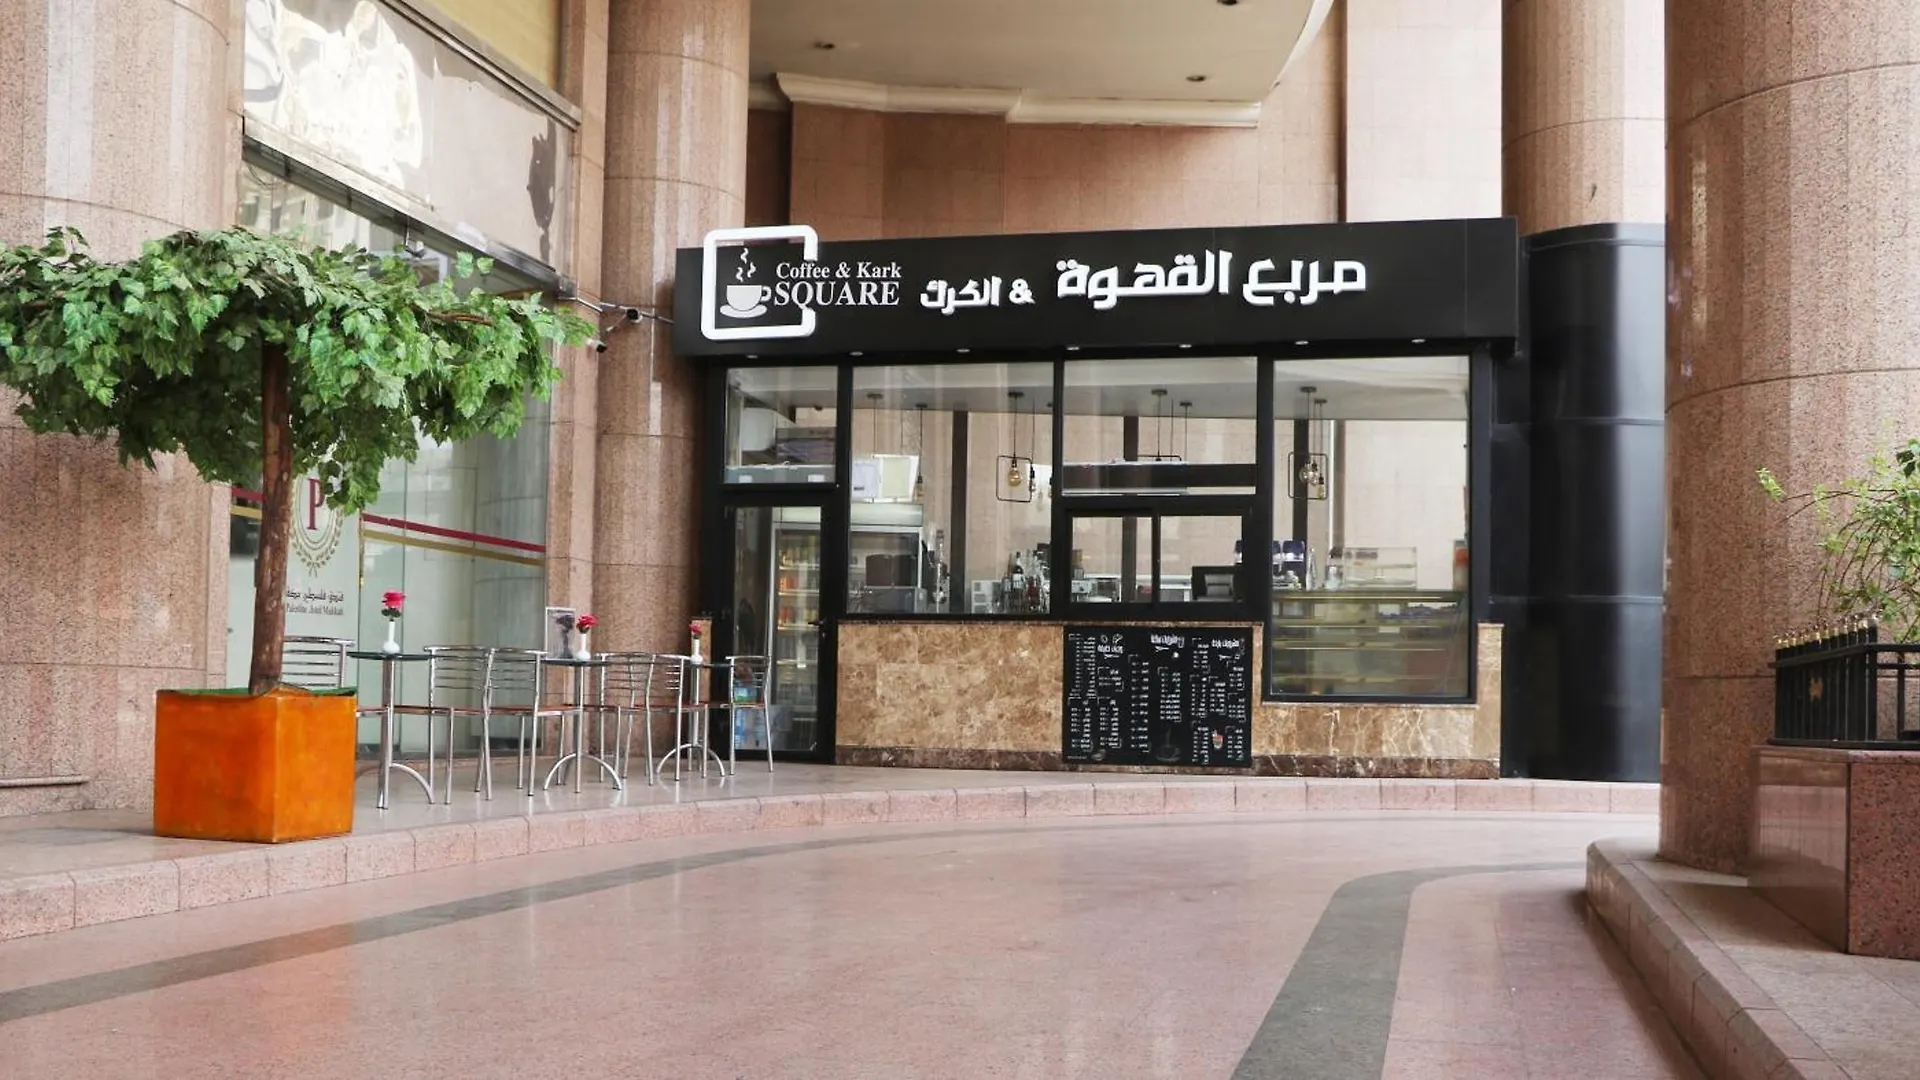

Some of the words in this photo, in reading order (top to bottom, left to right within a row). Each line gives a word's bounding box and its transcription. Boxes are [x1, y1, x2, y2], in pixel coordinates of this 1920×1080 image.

[776, 261, 830, 279] Coffee
[835, 261, 851, 279] &
[856, 261, 902, 279] Kark
[1056, 249, 1233, 310] القهوة
[1242, 257, 1367, 306] مربع
[774, 281, 900, 308] SQUARE
[920, 275, 1002, 315] الكرك
[1008, 278, 1035, 304] &
